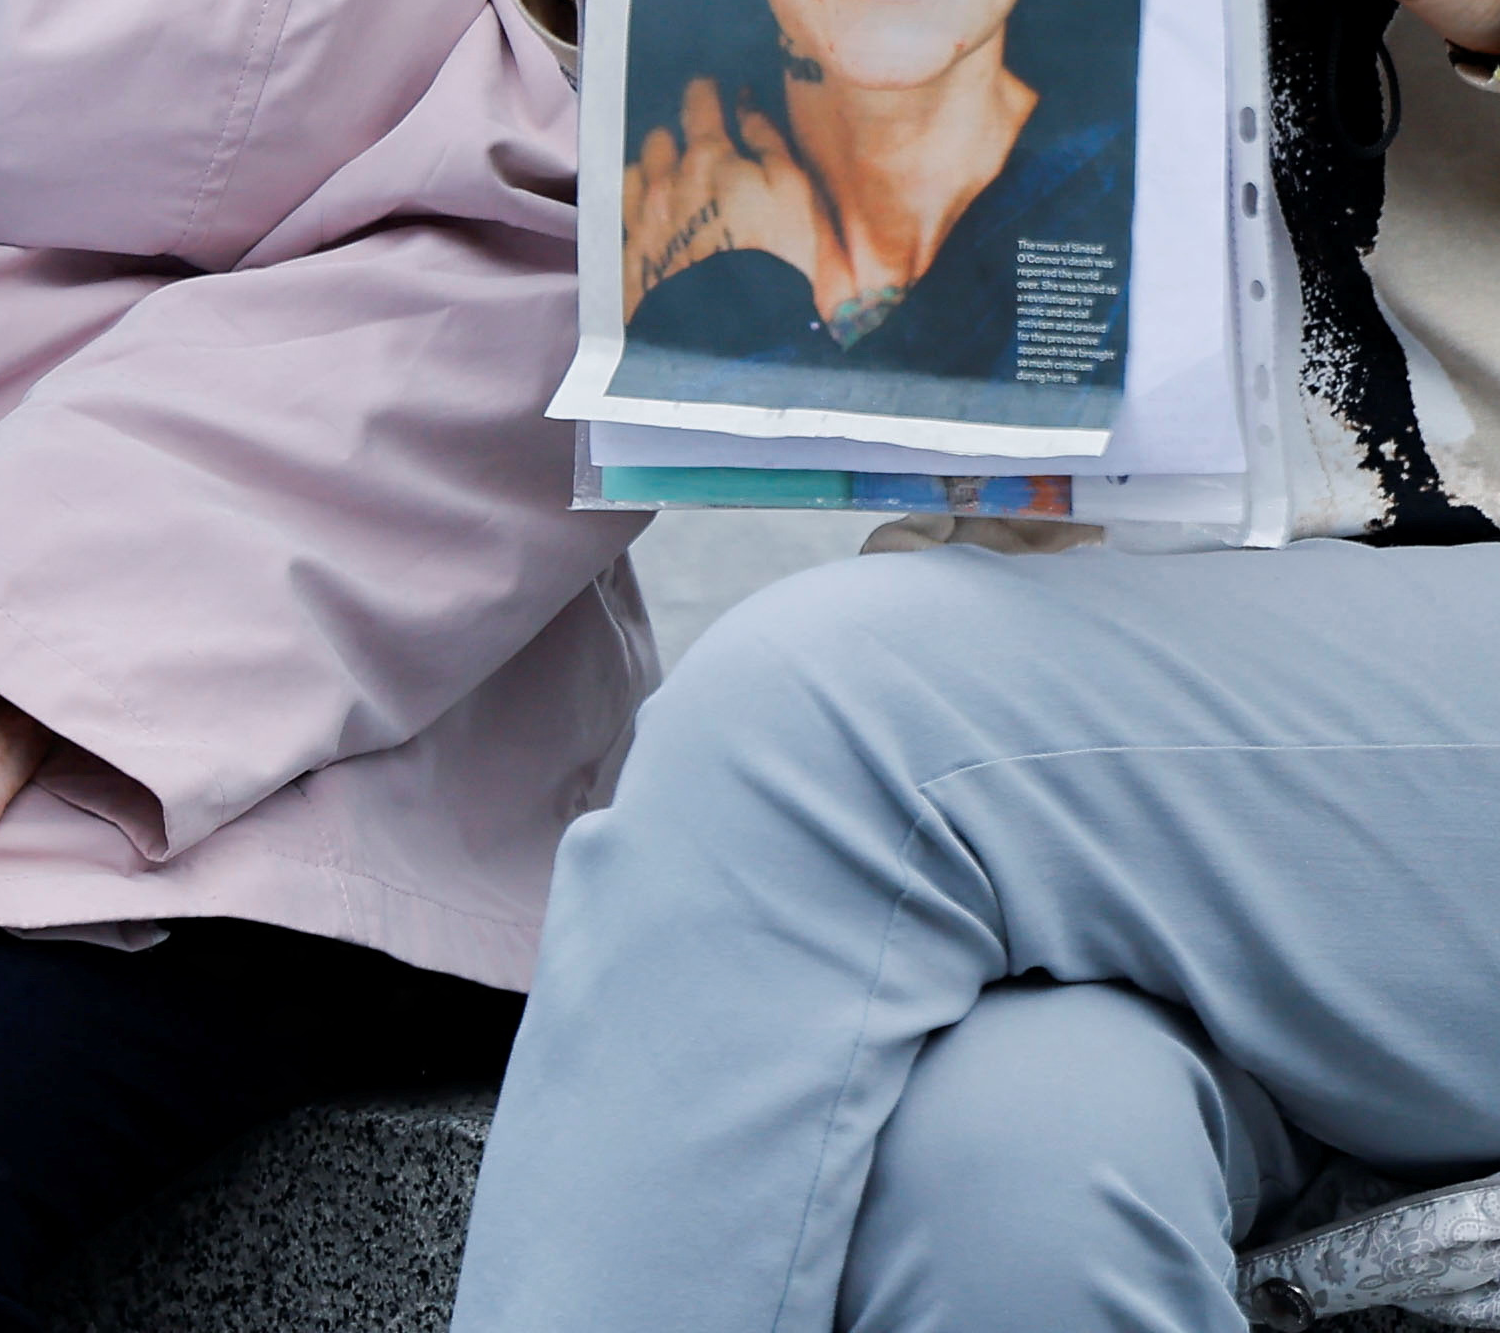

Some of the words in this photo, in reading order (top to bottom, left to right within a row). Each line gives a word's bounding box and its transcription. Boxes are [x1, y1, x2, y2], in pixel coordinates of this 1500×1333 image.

[1018, 240, 1035, 250] The
[1037, 242, 1059, 251] news
[1061, 243, 1069, 252] of
[1068, 258, 1093, 266] death
[1094, 260, 1114, 268] was
[1017, 267, 1056, 278] reported
[1058, 269, 1071, 278] the
[1072, 271, 1099, 280] world
[1041, 282, 1058, 291] She
[1078, 284, 1104, 293] hailed
[1106, 286, 1117, 294] as
[1024, 295, 1081, 306] revolutionary
[1083, 298, 1092, 306] in
[1046, 309, 1062, 317] and
[1018, 320, 1054, 328] activism
[1073, 324, 1106, 333] praised
[1018, 332, 1029, 341] for
[1031, 333, 1045, 342] the
[1018, 345, 1057, 357] approach
[1060, 348, 1077, 356] that
[1079, 349, 1114, 361] brought
[1029, 359, 1052, 368] much
[1054, 361, 1093, 371] criticism
[1016, 371, 1045, 383] during
[1047, 373, 1061, 382] her
[1063, 373, 1077, 383] life
